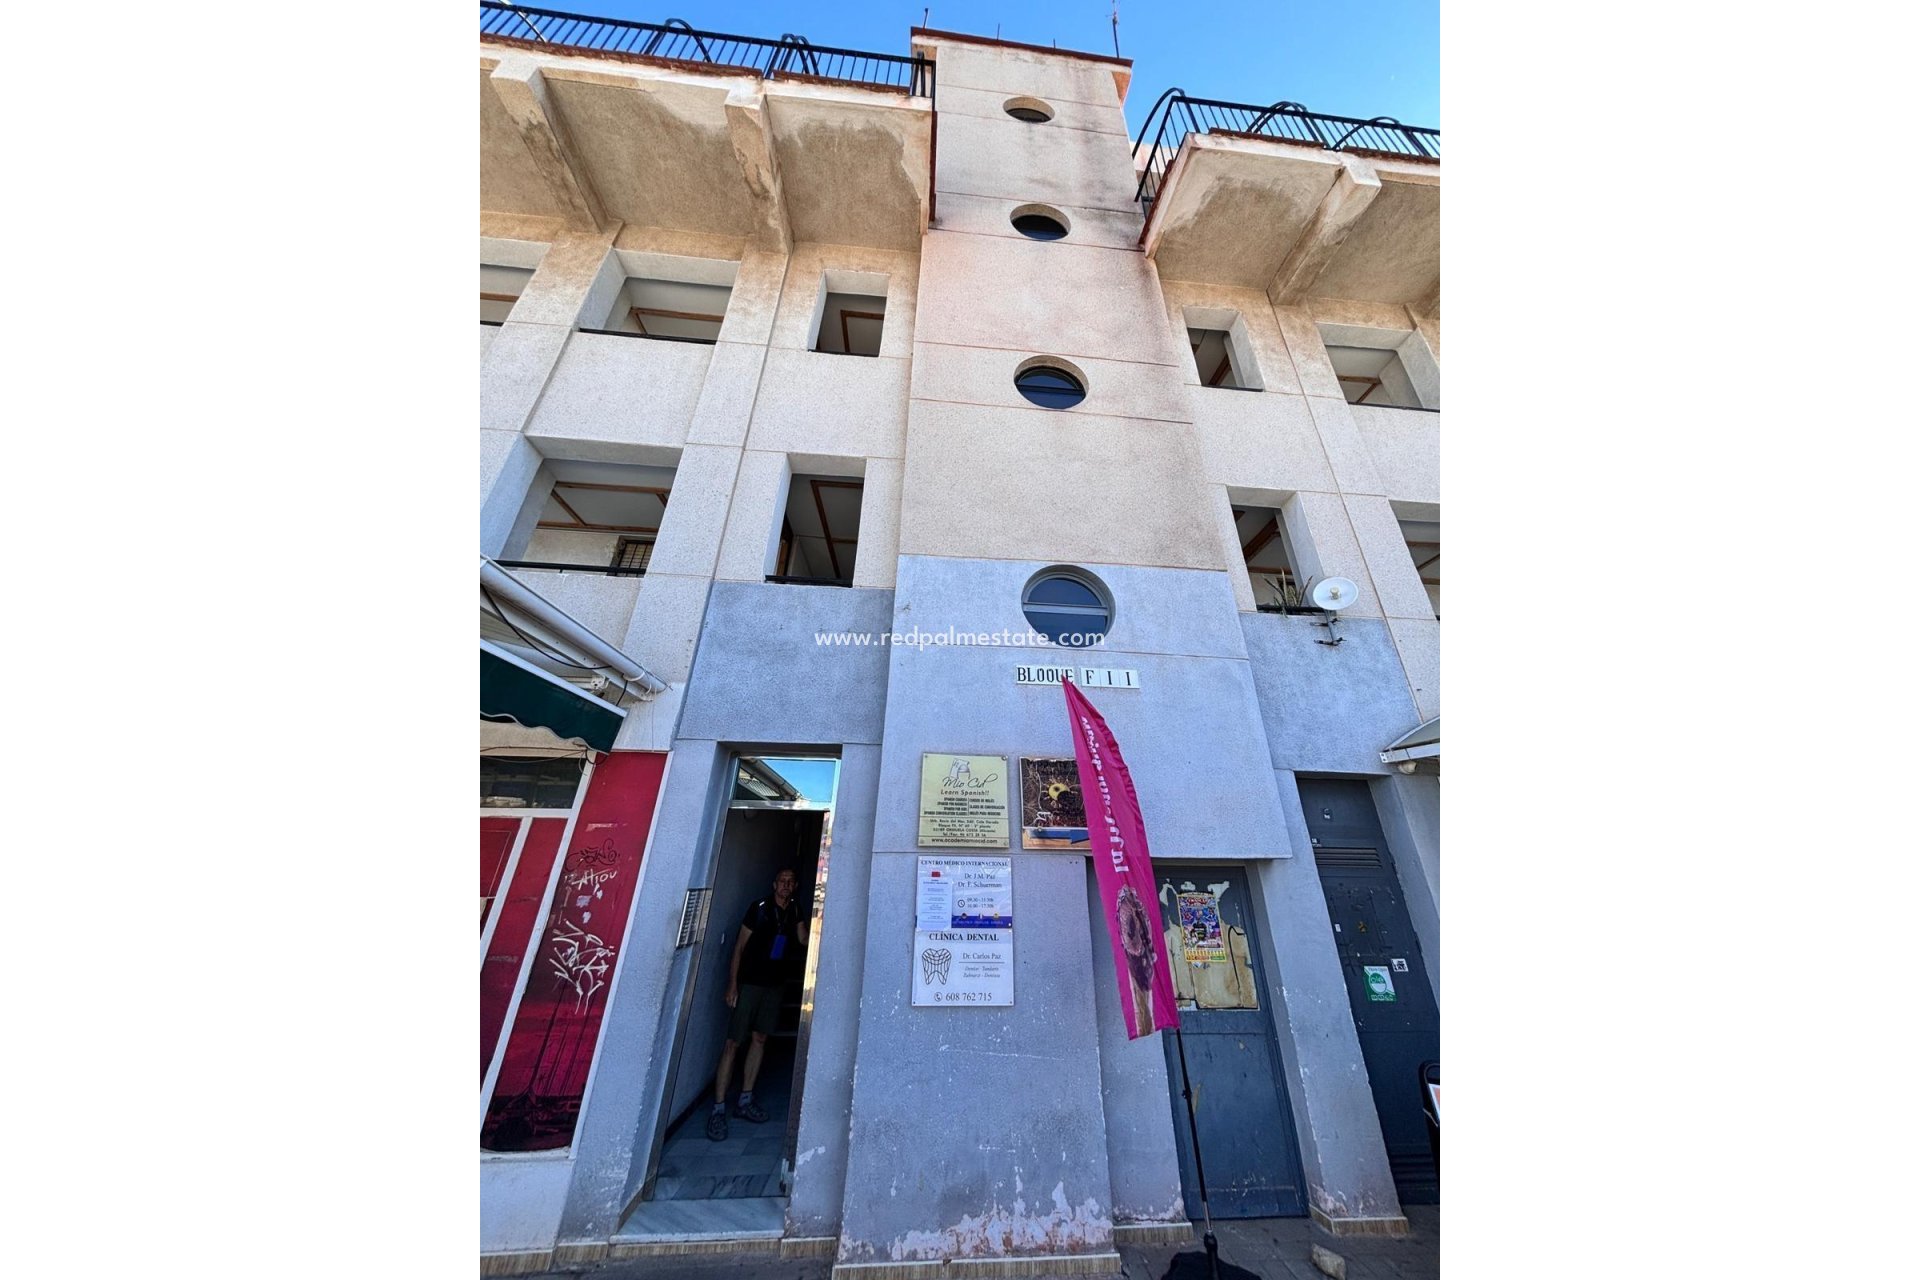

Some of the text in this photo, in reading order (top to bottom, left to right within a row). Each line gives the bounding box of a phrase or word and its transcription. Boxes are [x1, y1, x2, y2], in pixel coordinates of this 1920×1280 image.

[928, 931, 999, 941] CLÍNICA DENTAL
[962, 952, 970, 960] Dr.
[972, 952, 990, 960] Carlos
[945, 992, 992, 1001] 608 762 715
